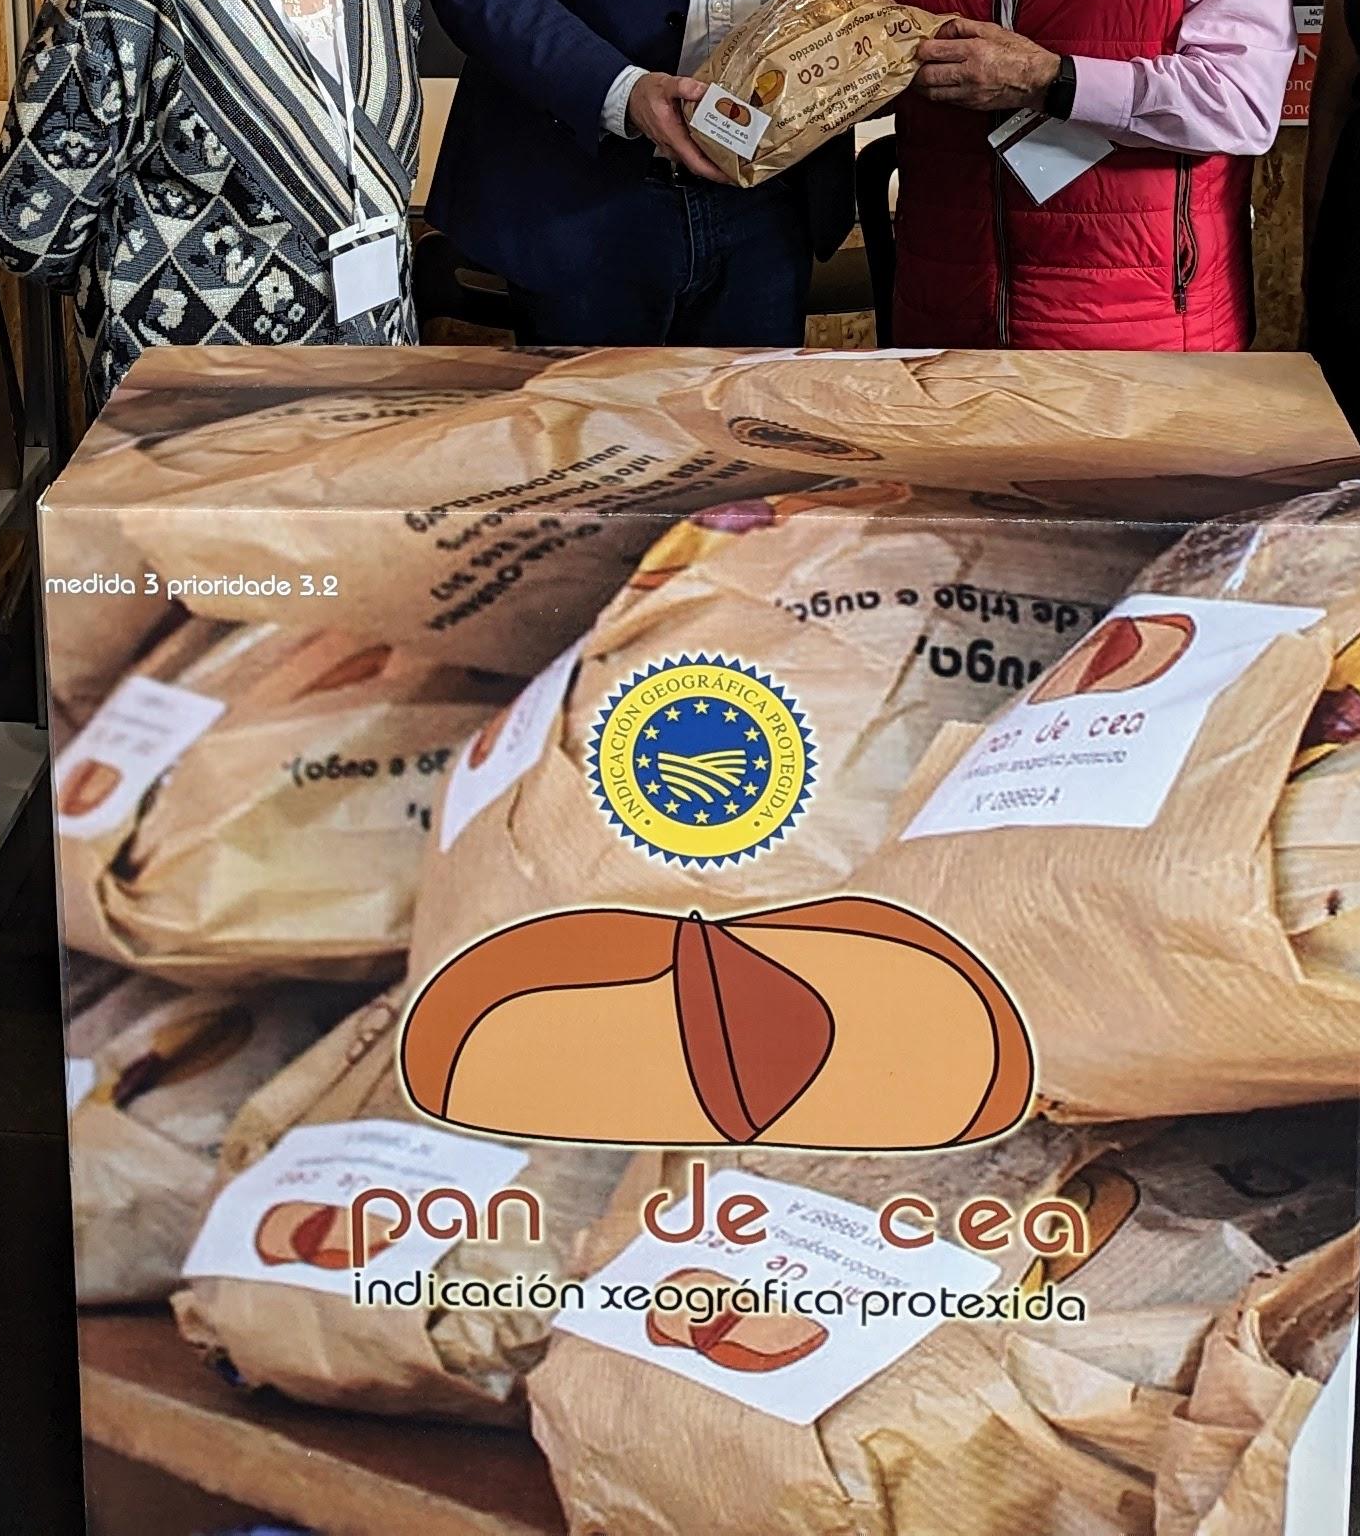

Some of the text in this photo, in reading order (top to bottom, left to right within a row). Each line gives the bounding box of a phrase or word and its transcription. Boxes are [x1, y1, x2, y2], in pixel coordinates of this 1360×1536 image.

[45, 574, 338, 600] medida 3 prioridade 3.2
[610, 673, 795, 820] INDICACIÓN GEOGRÁFICA PROTEGIDA
[350, 1188, 541, 1269] pan
[642, 1163, 769, 1245] de
[879, 1198, 1085, 1253] cea
[353, 1270, 1086, 1326] indicación xeográfica protexida
